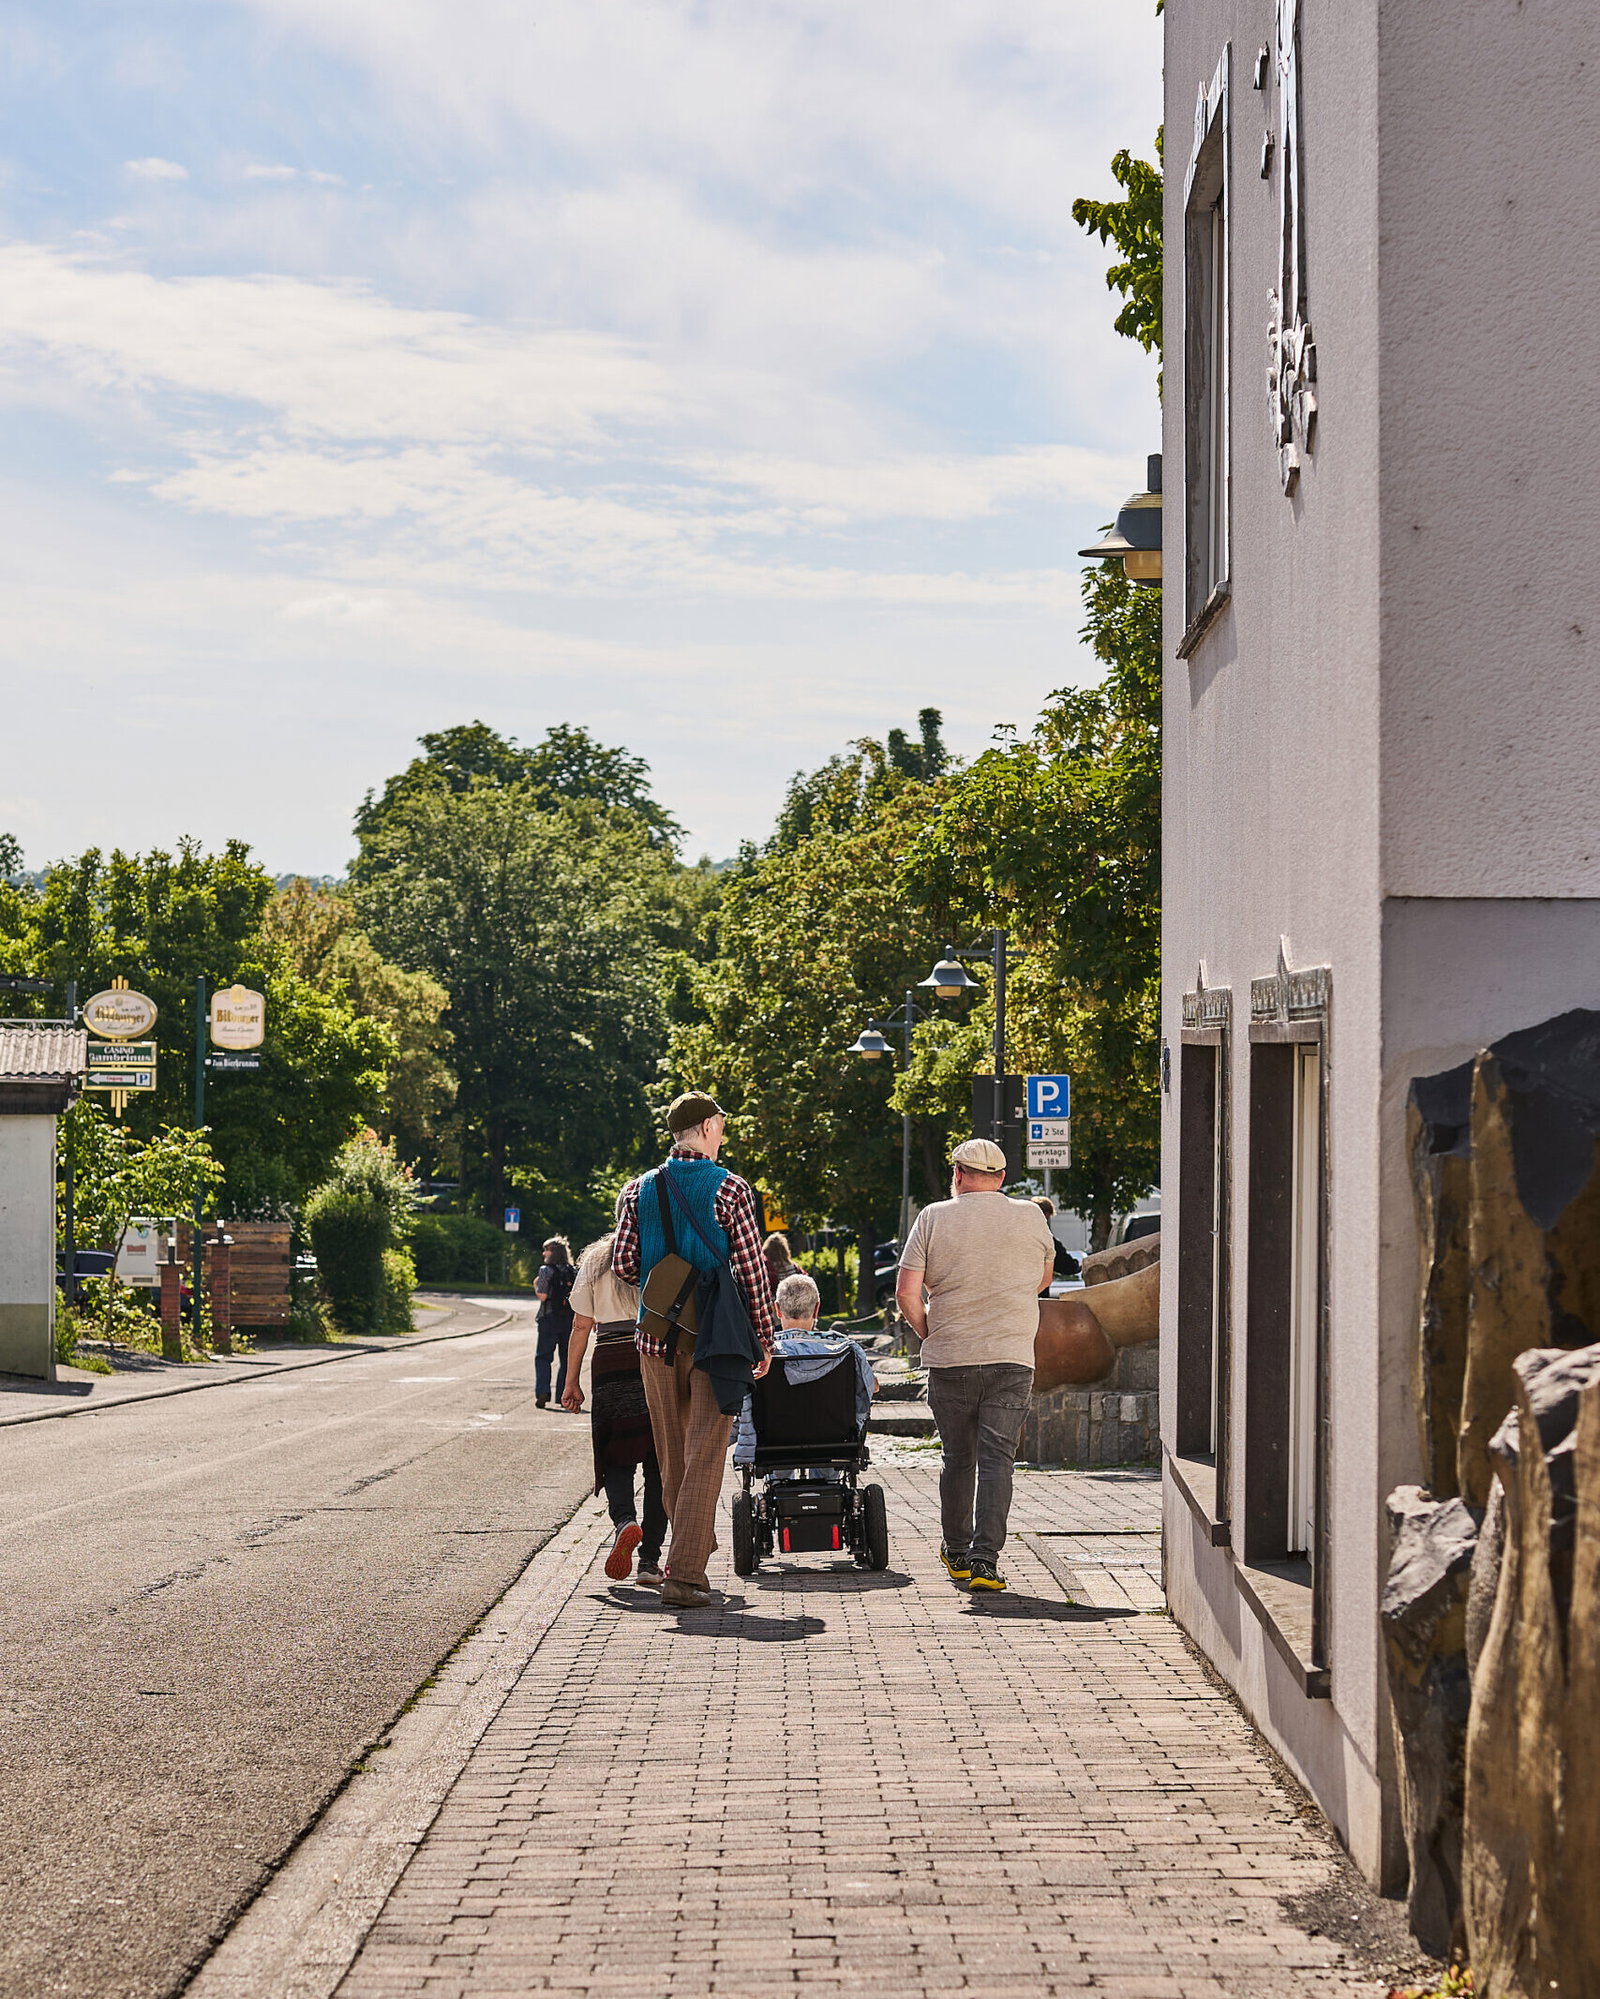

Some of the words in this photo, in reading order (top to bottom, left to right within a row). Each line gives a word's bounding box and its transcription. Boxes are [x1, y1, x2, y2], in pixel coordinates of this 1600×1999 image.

[103, 1046, 135, 1054] CASINO
[139, 1074, 148, 1084] P
[1037, 1081, 1060, 1113] P
[1045, 1127, 1050, 1136] 2
[1031, 1148, 1067, 1157] werktags
